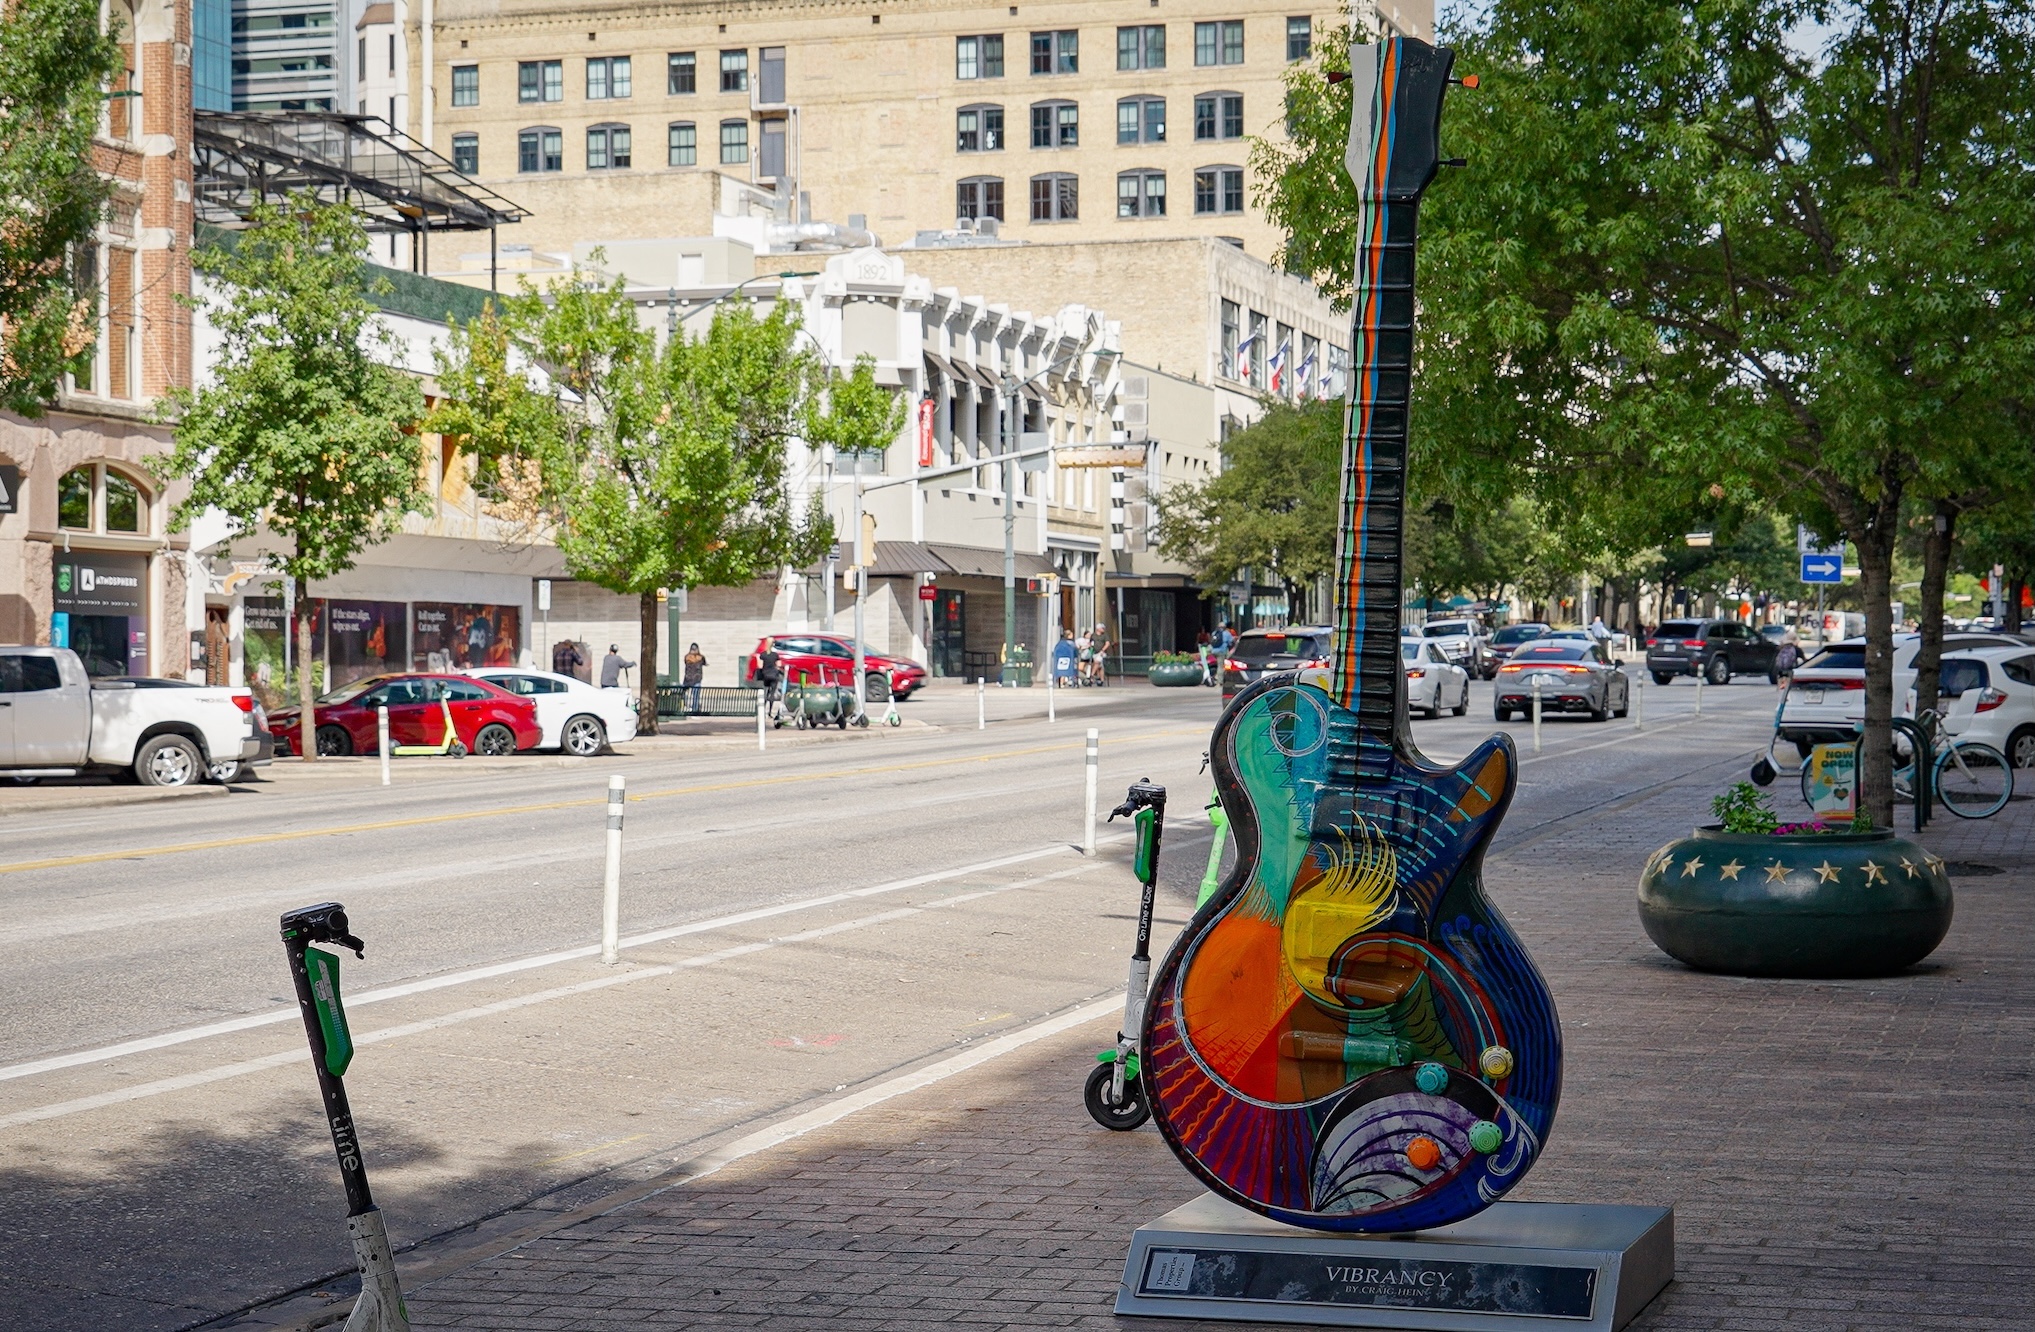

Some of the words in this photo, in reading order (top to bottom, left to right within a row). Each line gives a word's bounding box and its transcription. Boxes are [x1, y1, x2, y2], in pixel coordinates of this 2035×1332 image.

[858, 264, 887, 280] 1892
[923, 413, 931, 430] CVS
[96, 576, 138, 587] ATMOSPHERE
[1805, 614, 1839, 629] FeEx
[1825, 751, 1853, 759] NOW
[1821, 760, 1853, 768] OPEN
[1143, 885, 1153, 904] Uber
[1141, 910, 1150, 928] Lime
[1138, 929, 1147, 942] On
[1156, 1262, 1168, 1286] Thomas
[1164, 1256, 1178, 1286] Properties
[1173, 1267, 1185, 1287] Group
[1326, 1266, 1453, 1287] VIBRANCY
[1345, 1285, 1359, 1293] BY
[1361, 1286, 1394, 1295] CRAIG
[1397, 1288, 1424, 1296] HEIN
